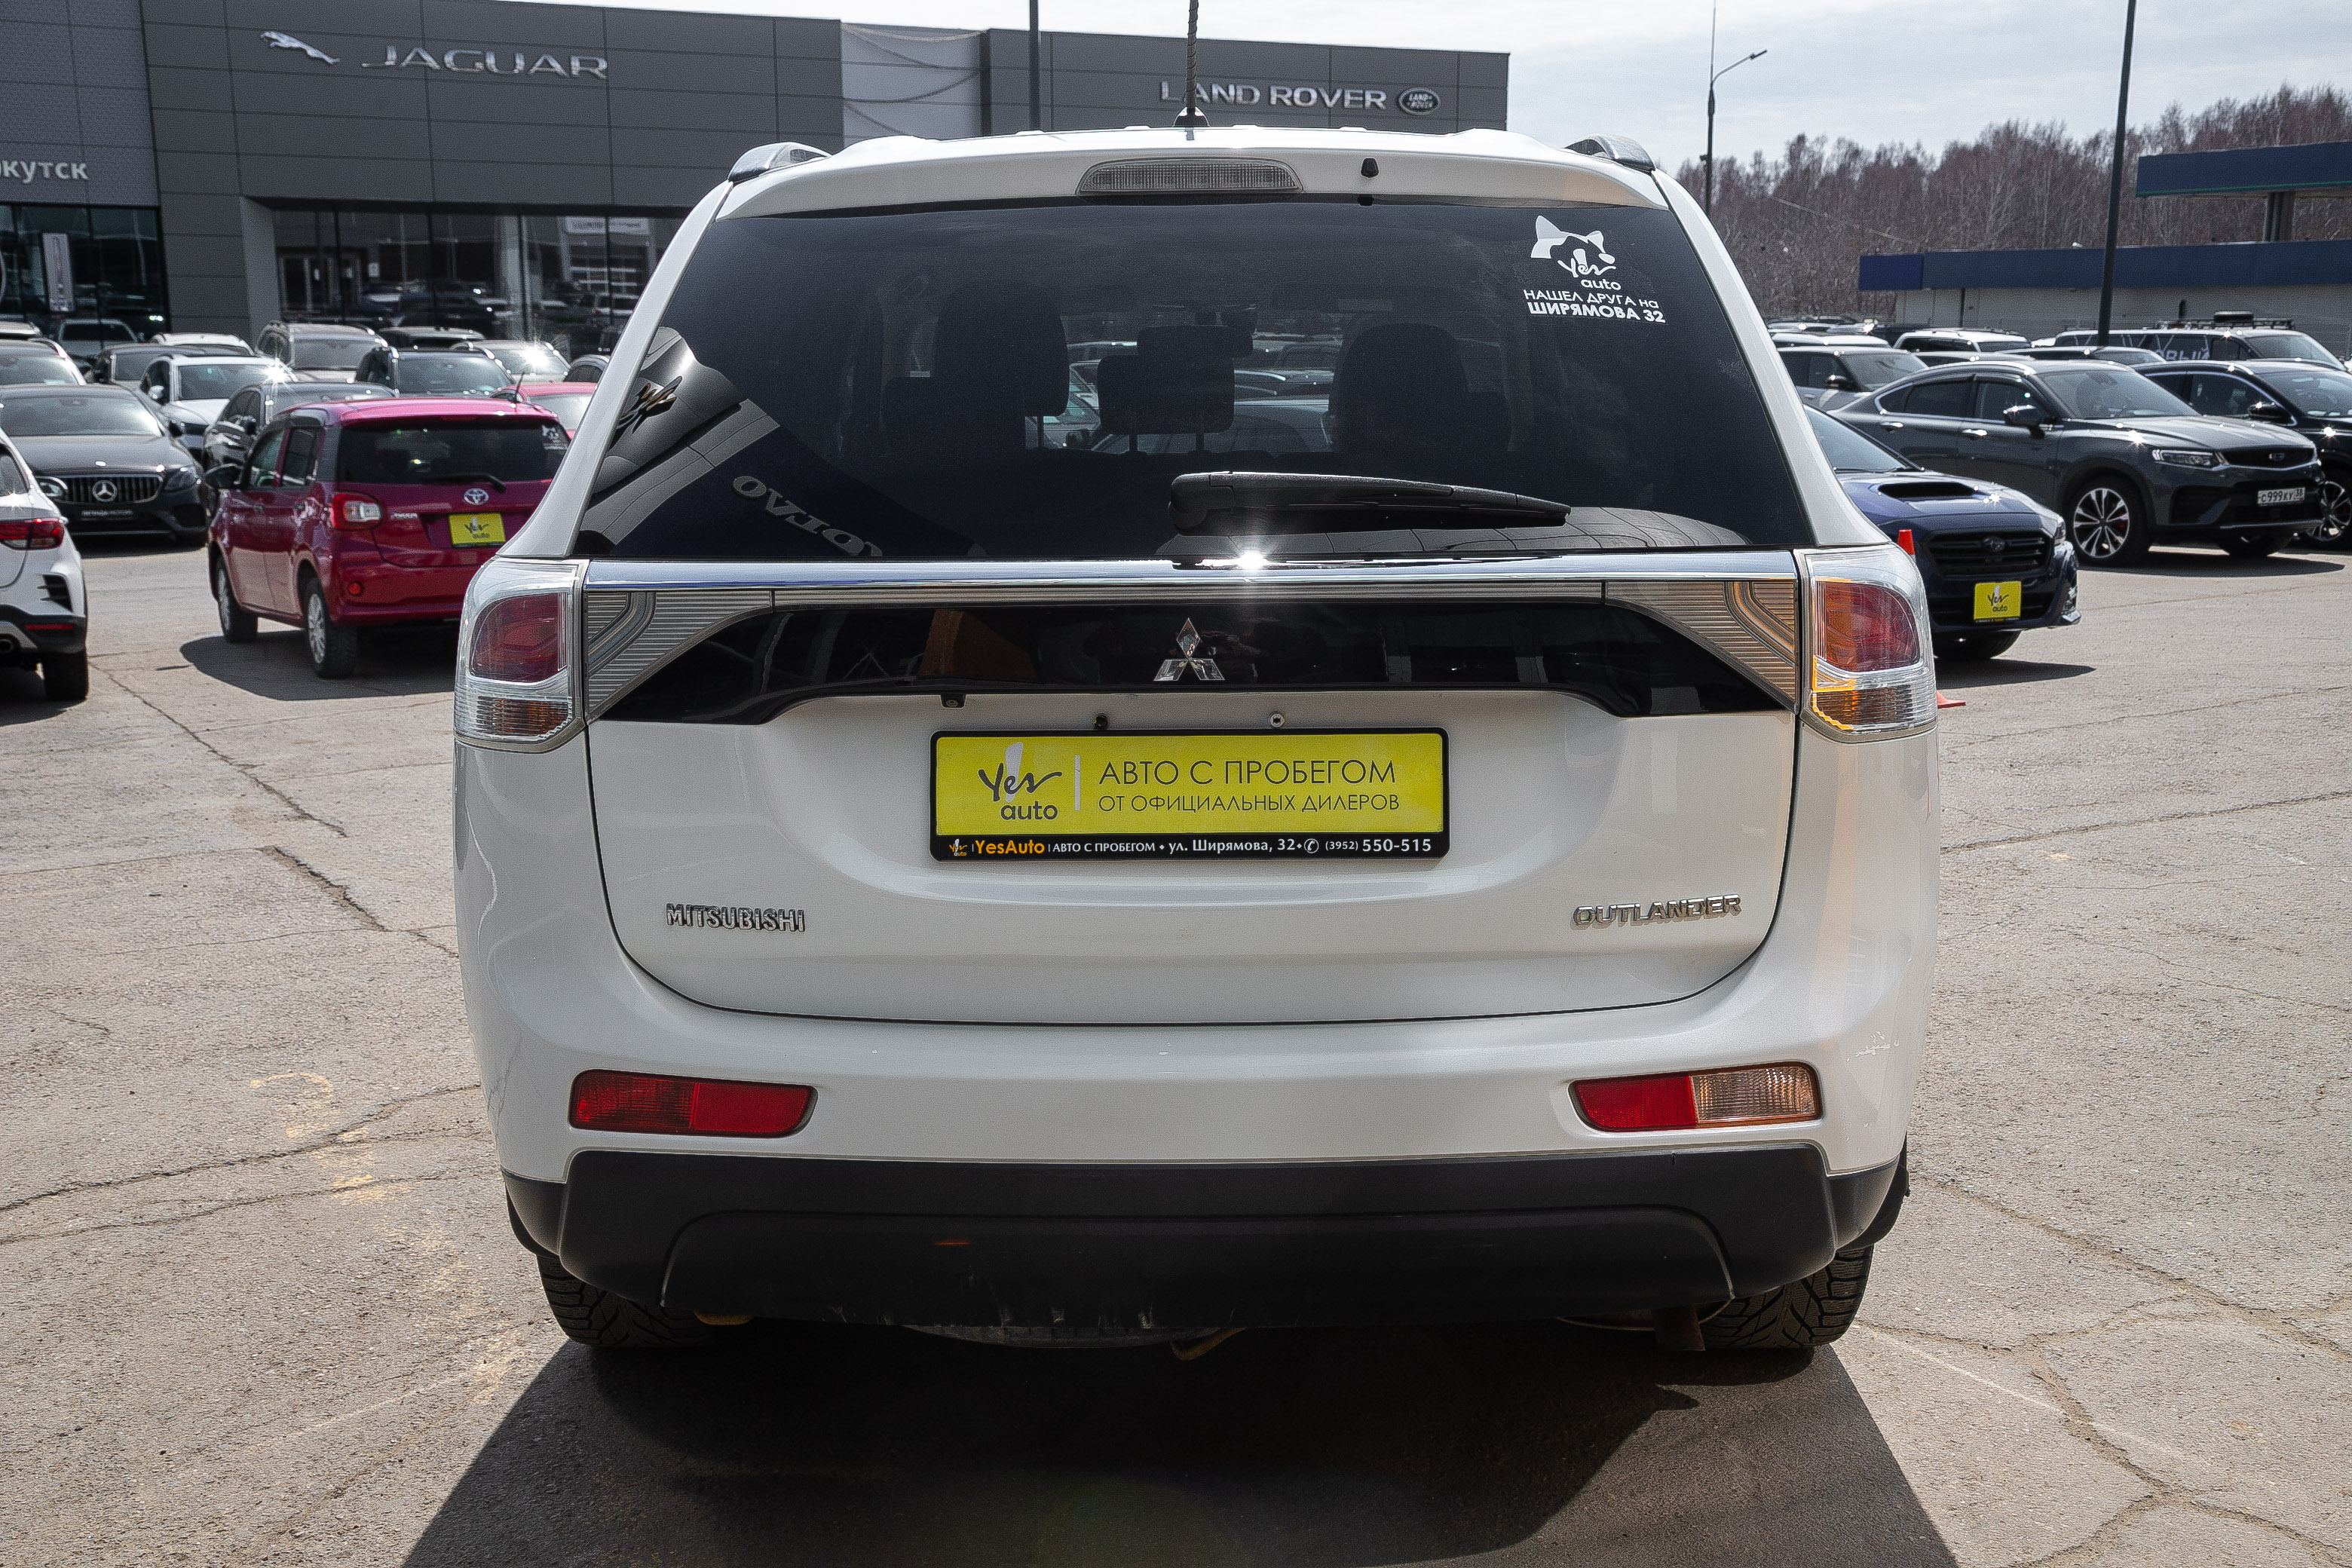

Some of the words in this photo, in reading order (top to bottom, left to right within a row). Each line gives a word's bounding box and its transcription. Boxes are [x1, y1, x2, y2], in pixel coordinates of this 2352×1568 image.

[361, 45, 608, 79] JAGUAR
[1269, 85, 1387, 110] ROVER
[0, 160, 89, 183] кутск
[1581, 278, 1621, 290] auto
[1524, 289, 1583, 302] НАШЕЛ
[1587, 292, 1637, 306] ДРУГА
[1527, 302, 1641, 320] ШИРЯМОВА
[1643, 309, 1666, 323] 32
[978, 761, 1062, 801] Yes
[1098, 761, 1180, 786] АВТО
[1189, 760, 1213, 785] С
[1225, 759, 1396, 785] ПРОБЕГОМ
[1000, 801, 1058, 820] auto
[1098, 795, 1125, 813] ОТ
[1131, 795, 1296, 813] ОФИЦИАЛЬНЫХ
[1302, 794, 1400, 813] ДИЛЕРОВ
[975, 839, 1045, 854] YesAuto
[1052, 843, 1081, 853] АВТО
[1084, 843, 1092, 853] С
[1095, 842, 1156, 853] ПРОБЕГОМ
[1168, 841, 1188, 854] ул.
[1193, 839, 1272, 853] Ширямова,
[1277, 839, 1296, 850] 32
[1325, 840, 1358, 851] (3952)
[1362, 839, 1432, 853] 550-515
[666, 903, 806, 932] MITSUBISHI
[1573, 894, 1742, 926] OUTLANDER
